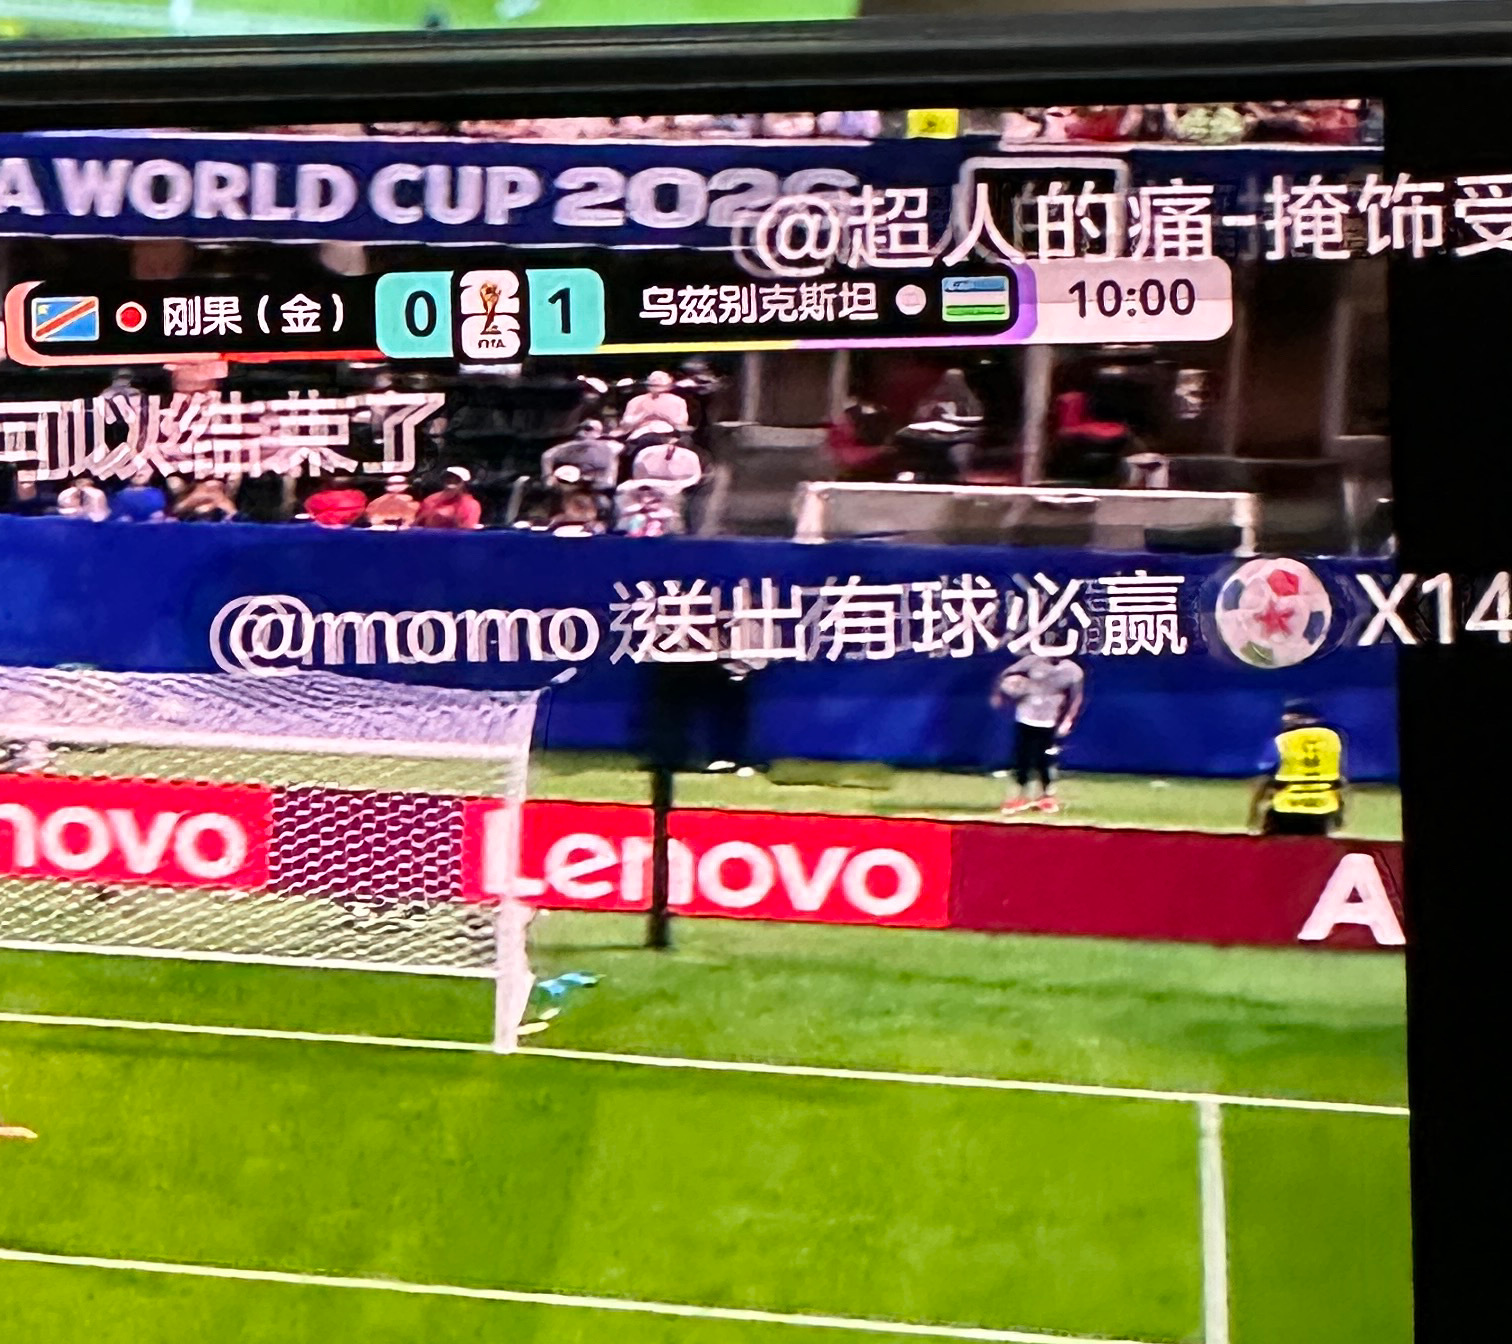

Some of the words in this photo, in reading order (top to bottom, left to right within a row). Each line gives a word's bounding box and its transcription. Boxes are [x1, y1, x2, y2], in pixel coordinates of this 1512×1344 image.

[55, 158, 358, 224] WORLD
[369, 162, 541, 226] CUP
[405, 290, 437, 337] 0
[548, 287, 571, 334] 1
[639, 281, 879, 326] 乌兹别克斯坦
[1067, 277, 1196, 319] 10:00
[209, 594, 600, 678] @momo
[610, 568, 1188, 665] 送出有球必赢
[484, 808, 922, 917] Lenovo
